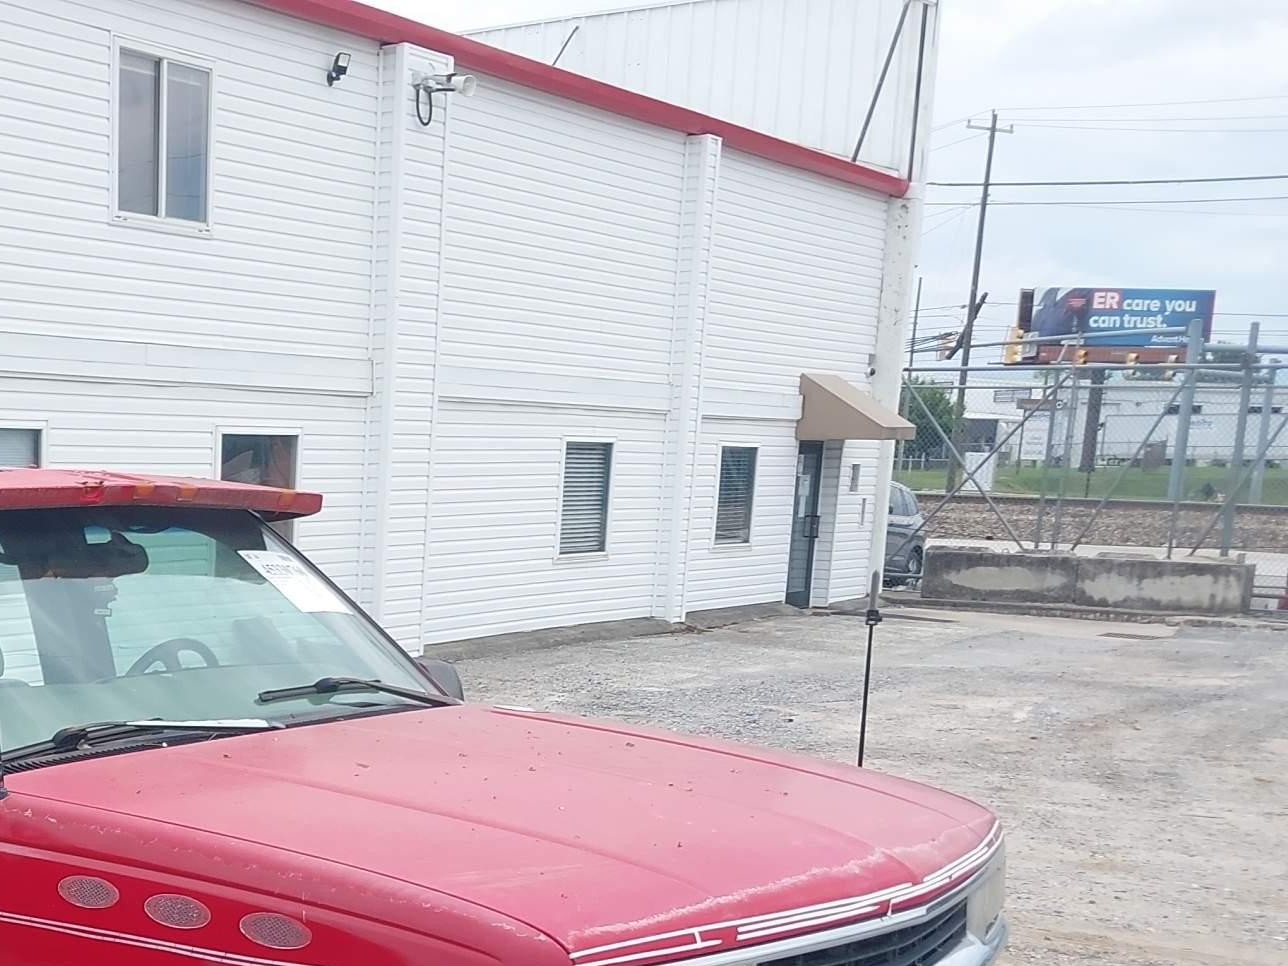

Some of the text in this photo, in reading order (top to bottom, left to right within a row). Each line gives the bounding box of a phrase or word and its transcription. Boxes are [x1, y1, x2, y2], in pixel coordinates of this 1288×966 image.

[1092, 291, 1197, 315] ER care you
[1089, 313, 1167, 328] can trust.
